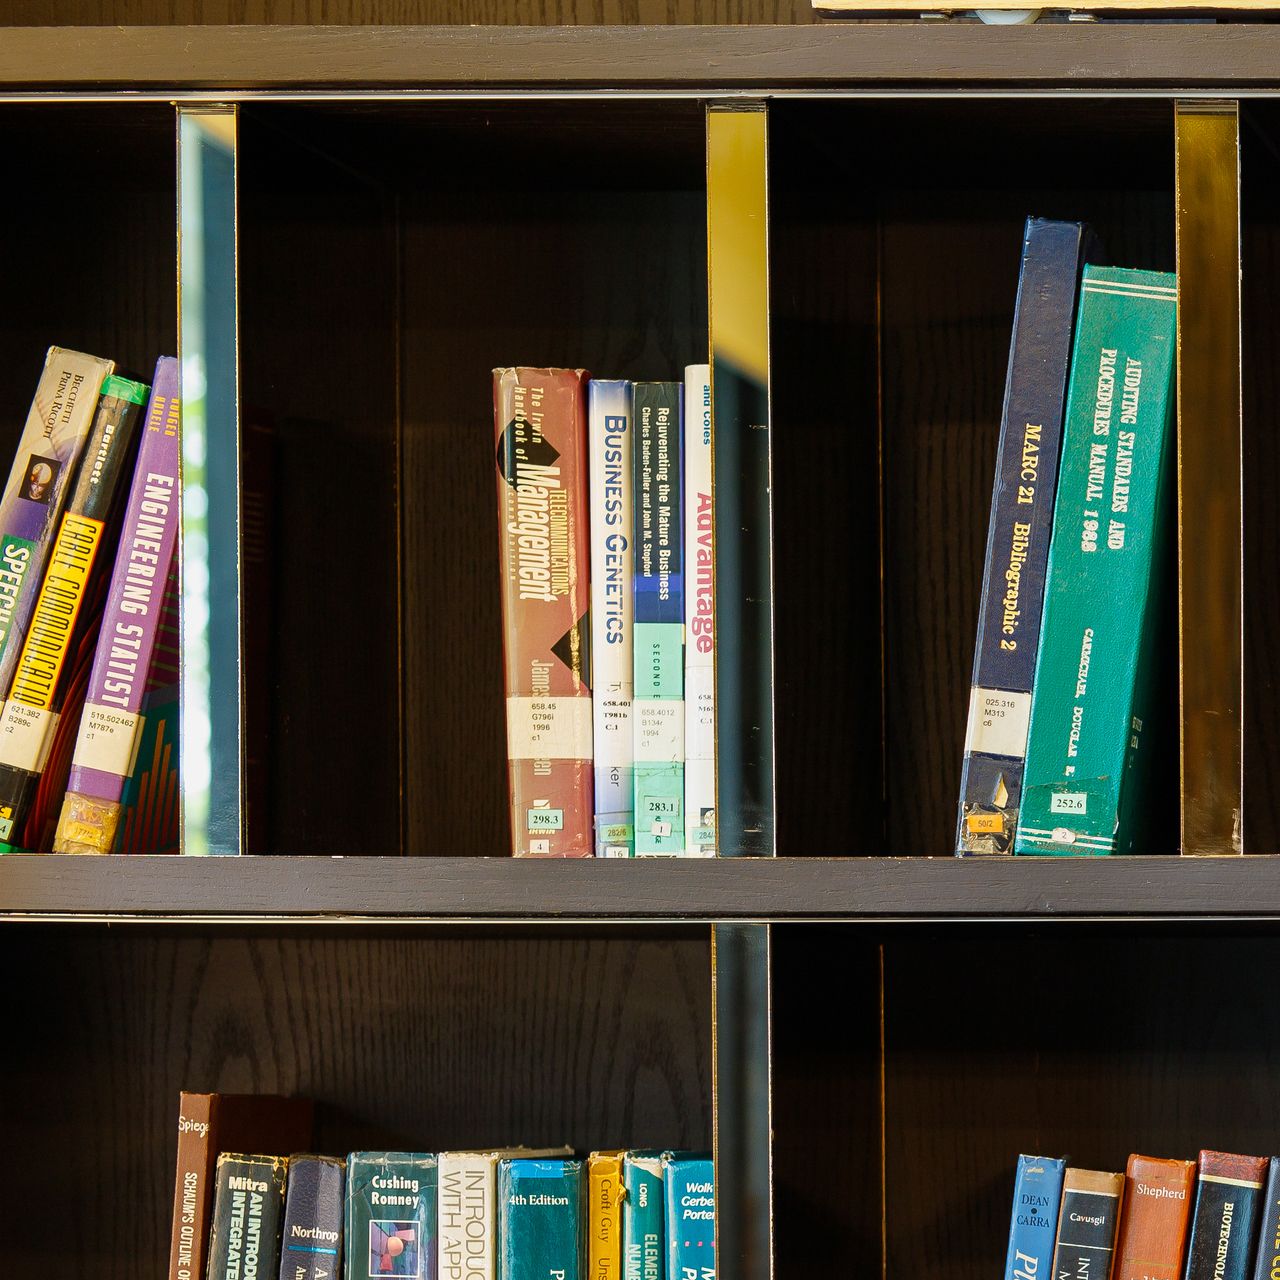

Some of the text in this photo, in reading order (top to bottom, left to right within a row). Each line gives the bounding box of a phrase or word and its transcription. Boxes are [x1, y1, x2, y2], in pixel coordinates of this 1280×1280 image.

[1019, 424, 1041, 482] MARC
[1108, 357, 1142, 550] AUDITING STANDARDS AND
[656, 407, 671, 600] Rejuvenating the Mature Business
[1017, 487, 1034, 505] 21
[54, 519, 98, 572] CABLE
[119, 473, 174, 614] ENGINEERING
[507, 463, 560, 601] Management
[1000, 523, 1031, 635] Bibliographic
[91, 711, 134, 727] 519.502462
[229, 1176, 267, 1189] Mitra
[1137, 1184, 1185, 1200] Shepherd
